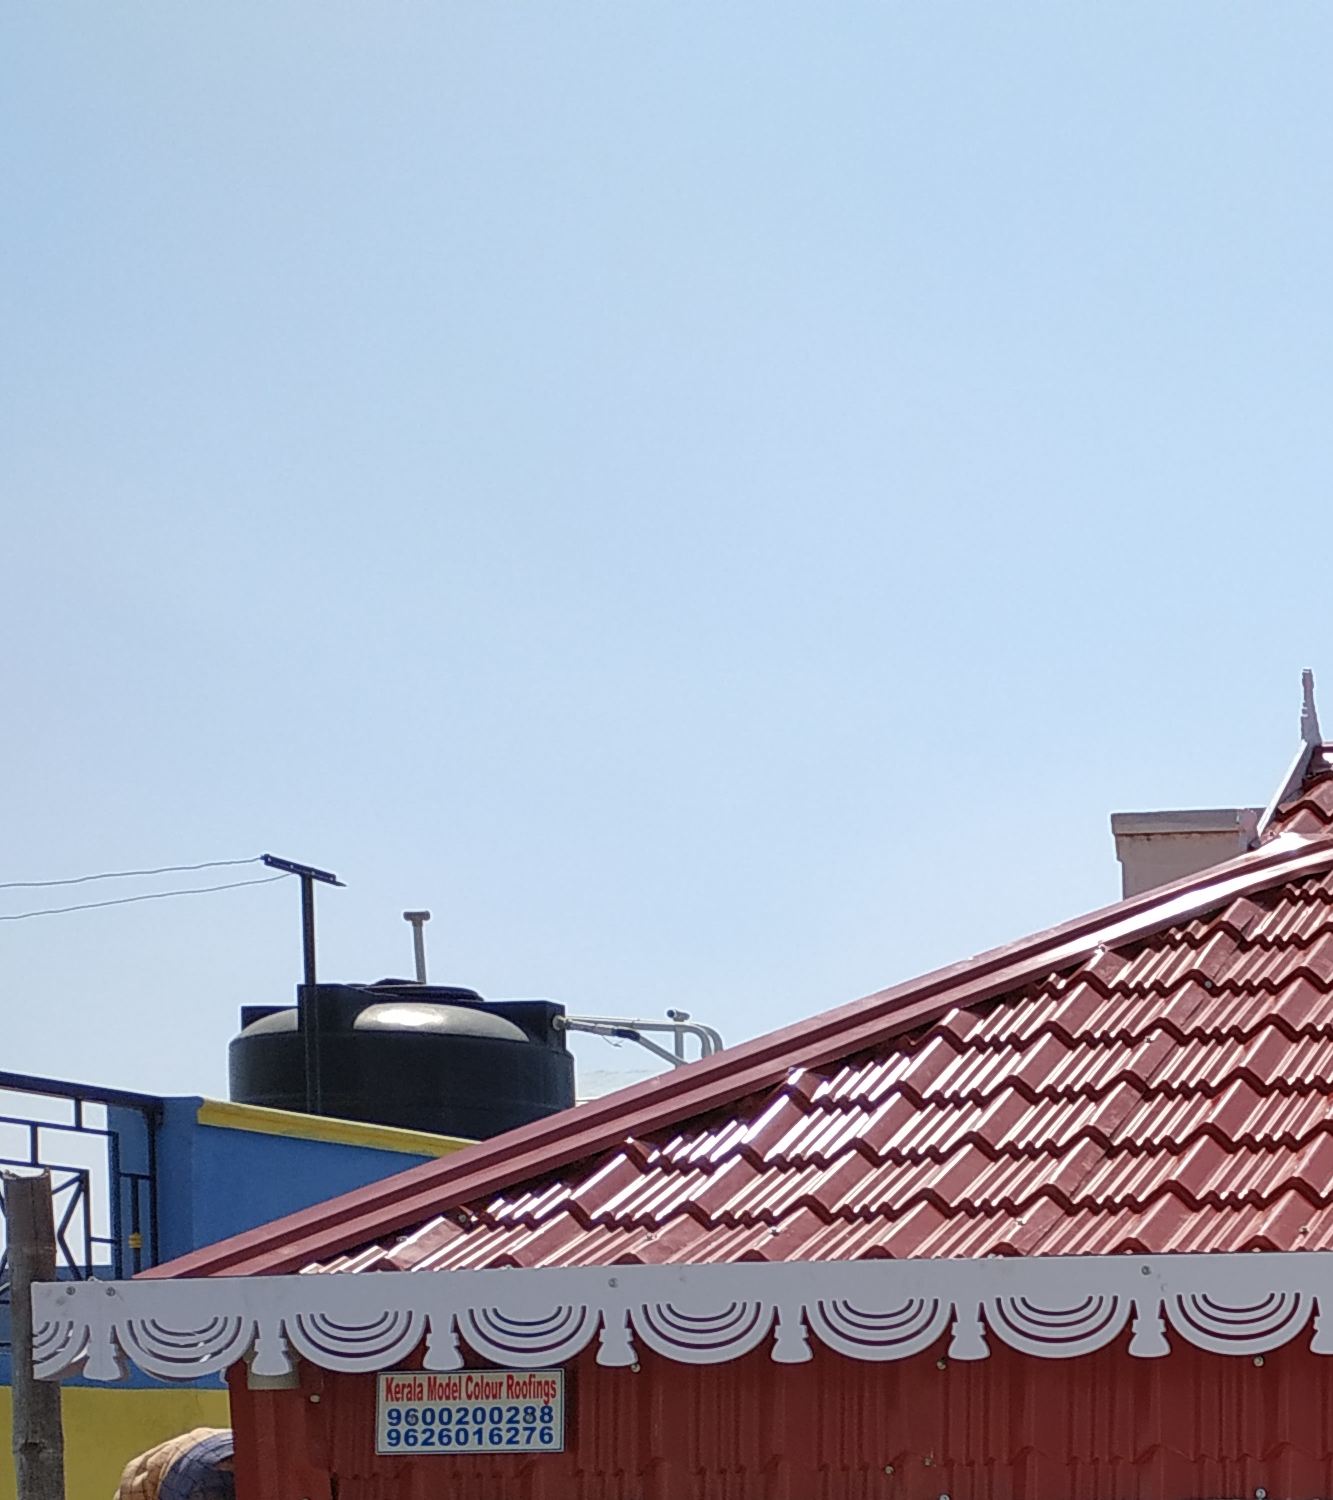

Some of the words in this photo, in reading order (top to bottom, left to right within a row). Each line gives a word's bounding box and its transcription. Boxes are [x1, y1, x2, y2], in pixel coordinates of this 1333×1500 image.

[385, 1376, 424, 1402] Kerala
[427, 1375, 462, 1401] Model
[464, 1374, 504, 1400] Colour
[506, 1373, 557, 1406] Roofings
[387, 1405, 554, 1427] 9600200288
[386, 1426, 554, 1447] 9626016276
